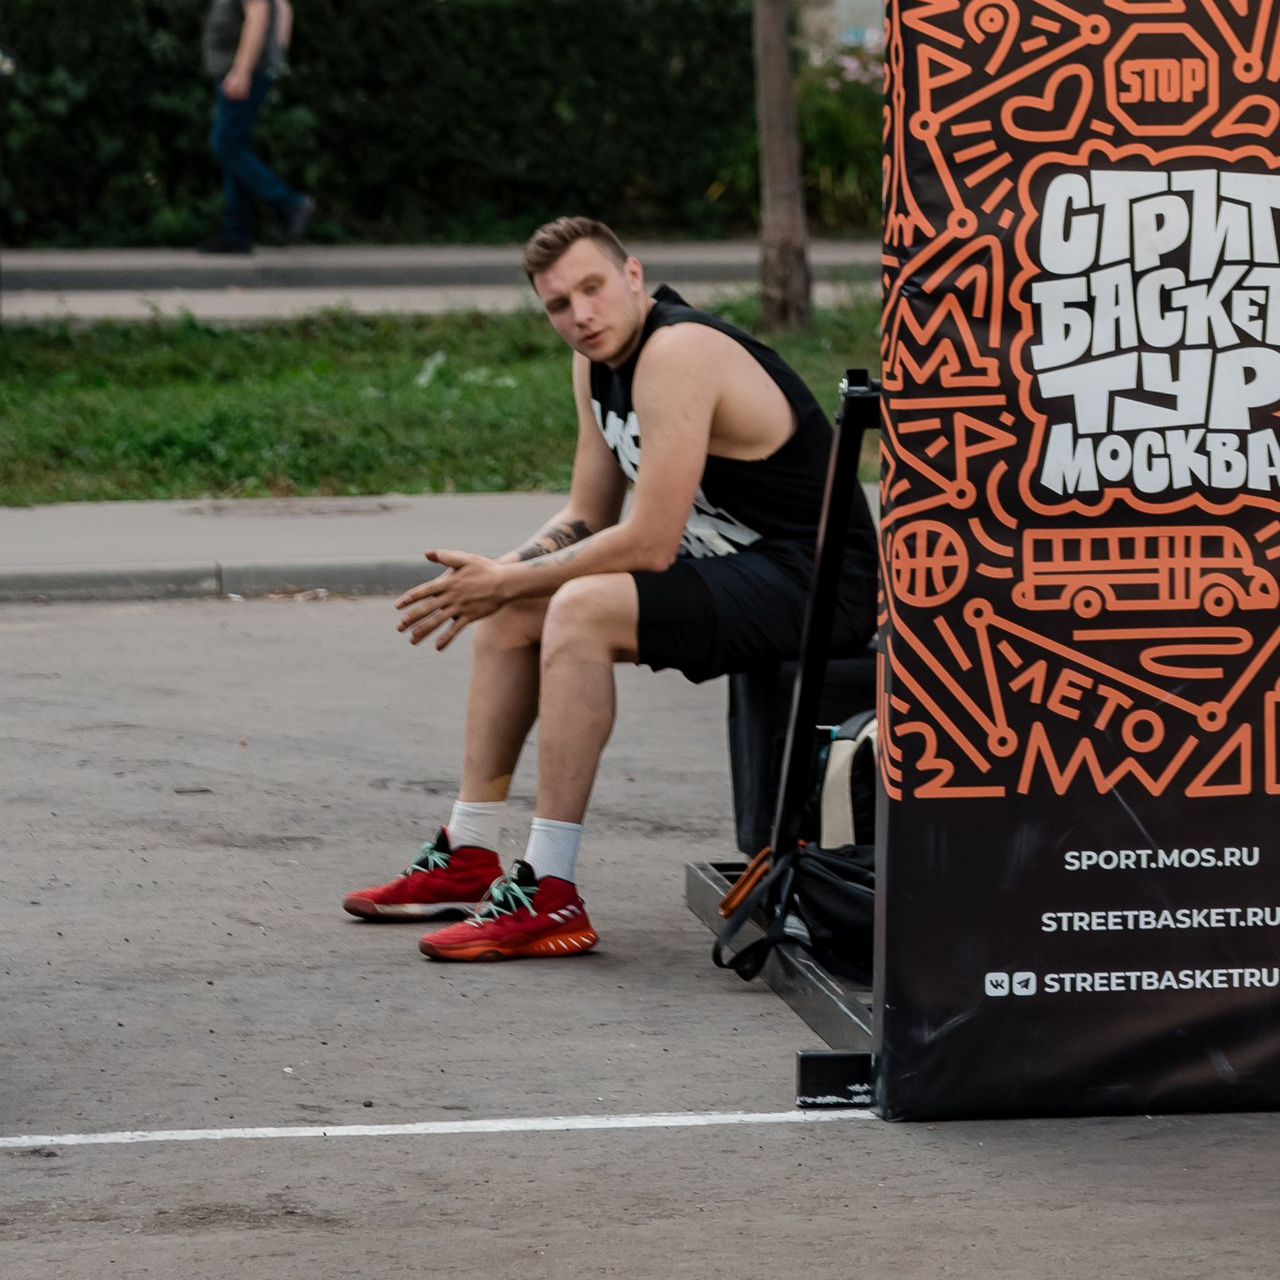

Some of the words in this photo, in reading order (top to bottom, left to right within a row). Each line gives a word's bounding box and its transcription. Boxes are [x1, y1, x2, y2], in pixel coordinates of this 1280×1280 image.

[1119, 57, 1206, 104] STOP
[1009, 659, 1165, 753] ЛЕТО
[1064, 846, 1261, 872] SPORT.MOS.RU
